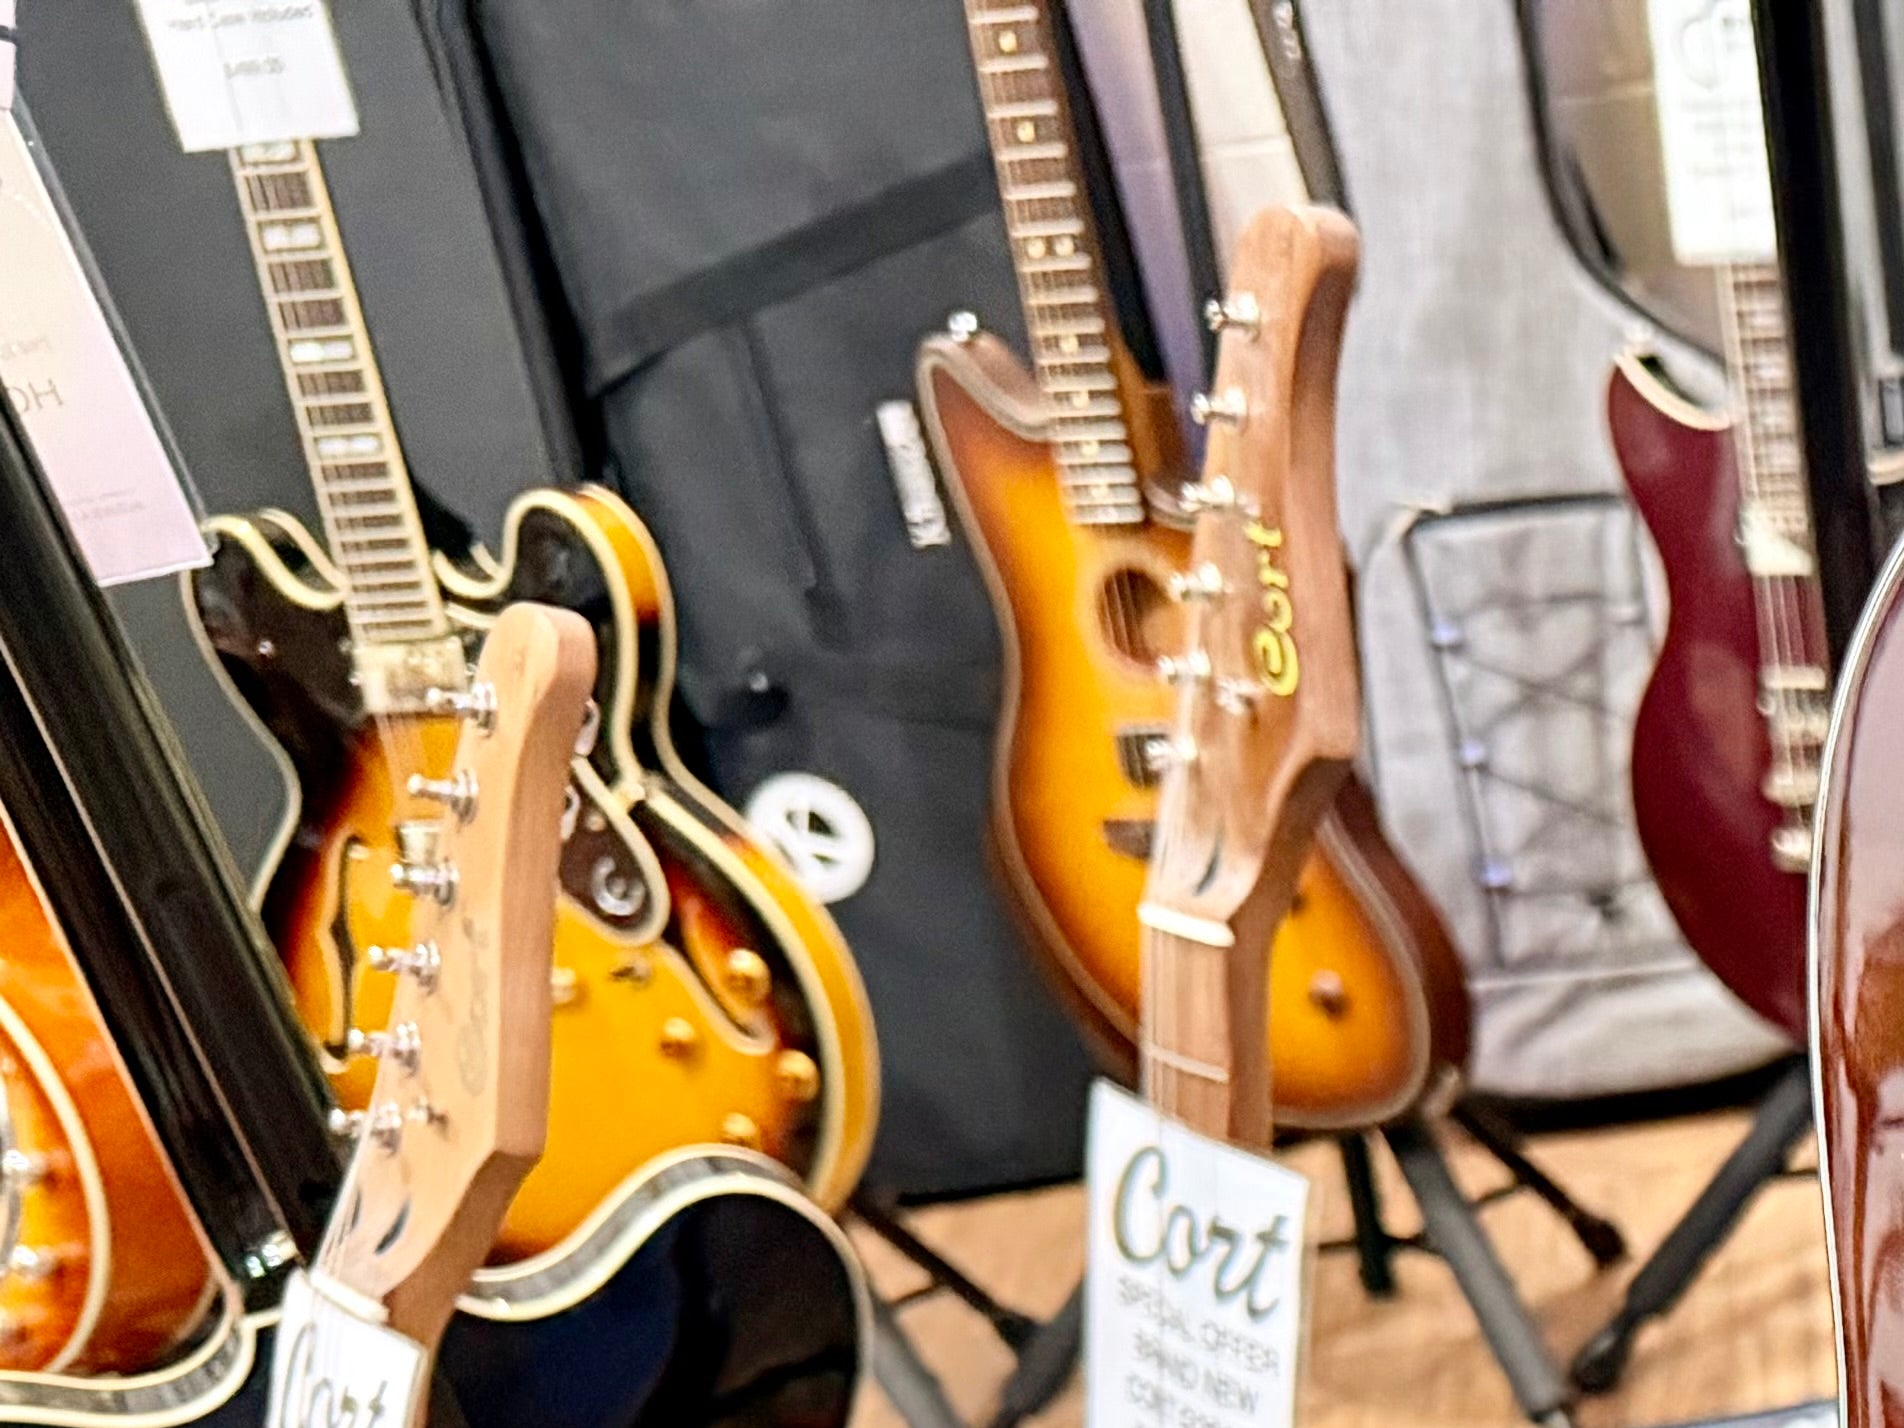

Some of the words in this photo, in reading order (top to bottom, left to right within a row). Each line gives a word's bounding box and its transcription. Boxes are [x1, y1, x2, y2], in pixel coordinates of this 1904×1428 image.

[1242, 520, 1300, 697] Cort
[1112, 1144, 1293, 1323] Cort
[1199, 1318, 1281, 1377] OFFER
[1203, 1368, 1260, 1415] NEW
